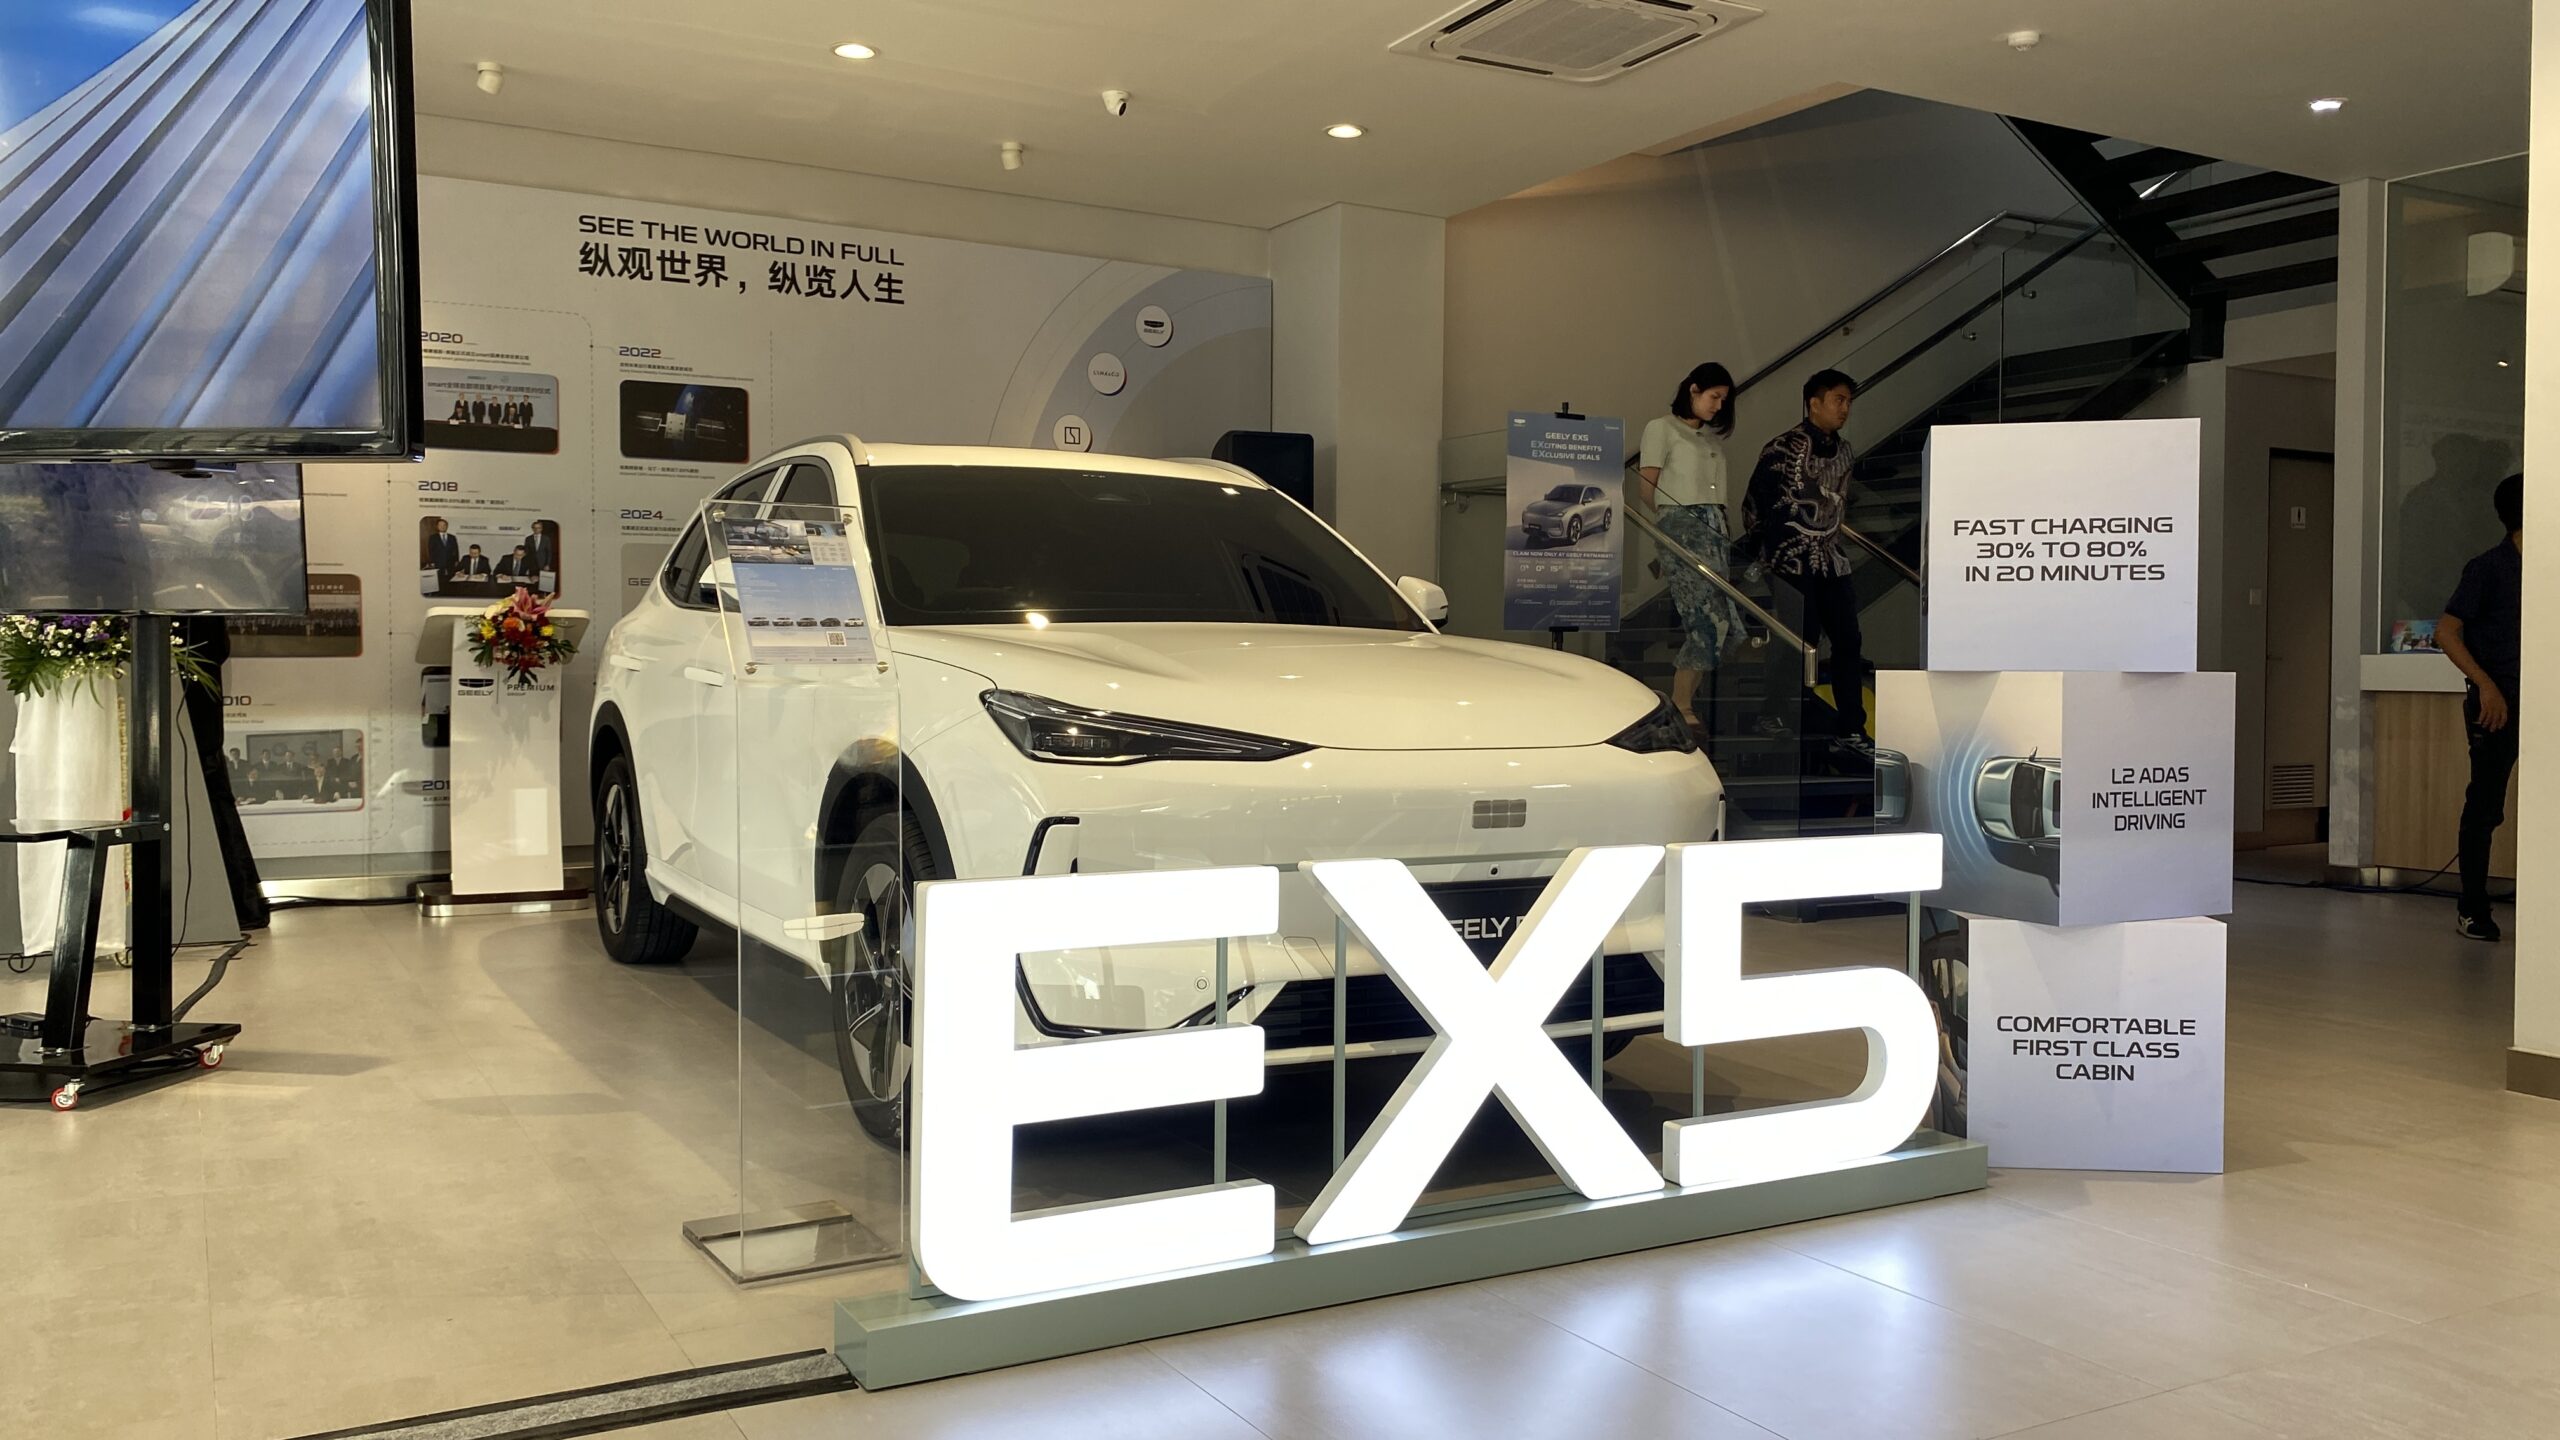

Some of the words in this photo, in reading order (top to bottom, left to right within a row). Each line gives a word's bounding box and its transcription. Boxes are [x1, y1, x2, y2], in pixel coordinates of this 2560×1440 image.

[579, 215, 634, 237] SEE
[641, 221, 698, 244] THE
[704, 228, 805, 255] WORLD
[811, 239, 834, 258] IN
[841, 243, 905, 266] FULL
[578, 241, 905, 305] 纵观世界，纵览人生
[421, 331, 463, 344] 2020
[619, 346, 661, 359] 2022
[1545, 432, 1570, 441] GEELY
[1568, 443, 1602, 452] BENEFITS
[1577, 453, 1600, 461] DEALS
[418, 480, 458, 492] 2018
[620, 509, 663, 521] 2024
[1953, 519, 2025, 536] FAST
[2030, 516, 2173, 535] CHARGING
[1976, 542, 2035, 559] 30%
[2041, 541, 2080, 559] TO
[2086, 540, 2147, 558] 80%
[1965, 566, 1989, 583] IN
[1996, 565, 2035, 582] 20
[2041, 563, 2165, 582] MINUTES
[506, 684, 555, 692] PREMIUM
[223, 695, 252, 706] 010
[2112, 768, 2134, 785] L2
[2139, 766, 2190, 784] ADAS
[422, 780, 450, 791] 201
[2092, 788, 2207, 809] INTELLIGENT
[2114, 812, 2186, 832] DRIVING
[1449, 916, 1511, 940] EELY
[1996, 1015, 2196, 1036] COMFORTABLE
[2012, 1039, 2088, 1056] FIRST
[2092, 1041, 2180, 1059] CLASS
[914, 833, 1943, 1302] EX5
[2055, 1063, 2135, 1082] CABIN
